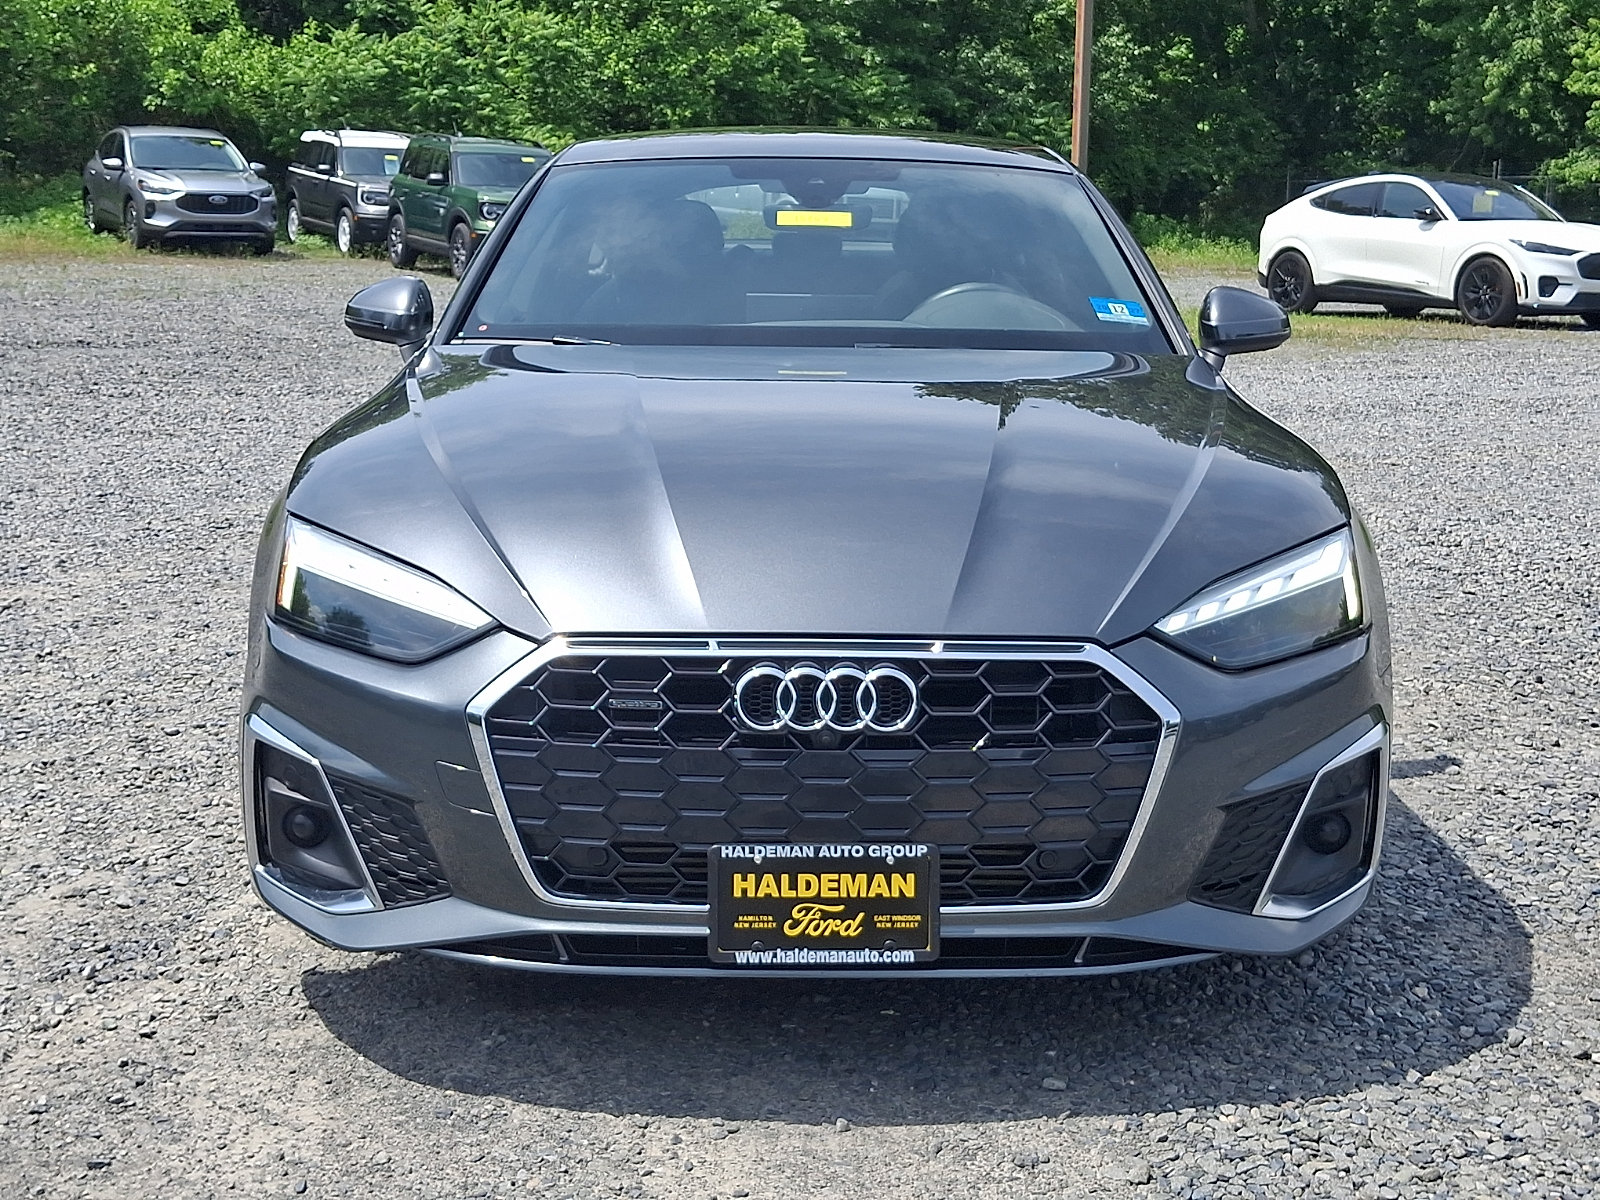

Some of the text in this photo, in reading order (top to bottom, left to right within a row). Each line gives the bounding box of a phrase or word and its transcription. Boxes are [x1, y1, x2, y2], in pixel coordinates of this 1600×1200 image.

[1112, 304, 1125, 313] 12
[721, 844, 928, 858] HALDEMAN AUTO GROUP
[733, 873, 915, 898] HALDEMAN
[783, 903, 866, 937] Ford
[873, 914, 921, 922] EAST WINDSOR
[735, 948, 915, 964] www.haldemanauto.com
